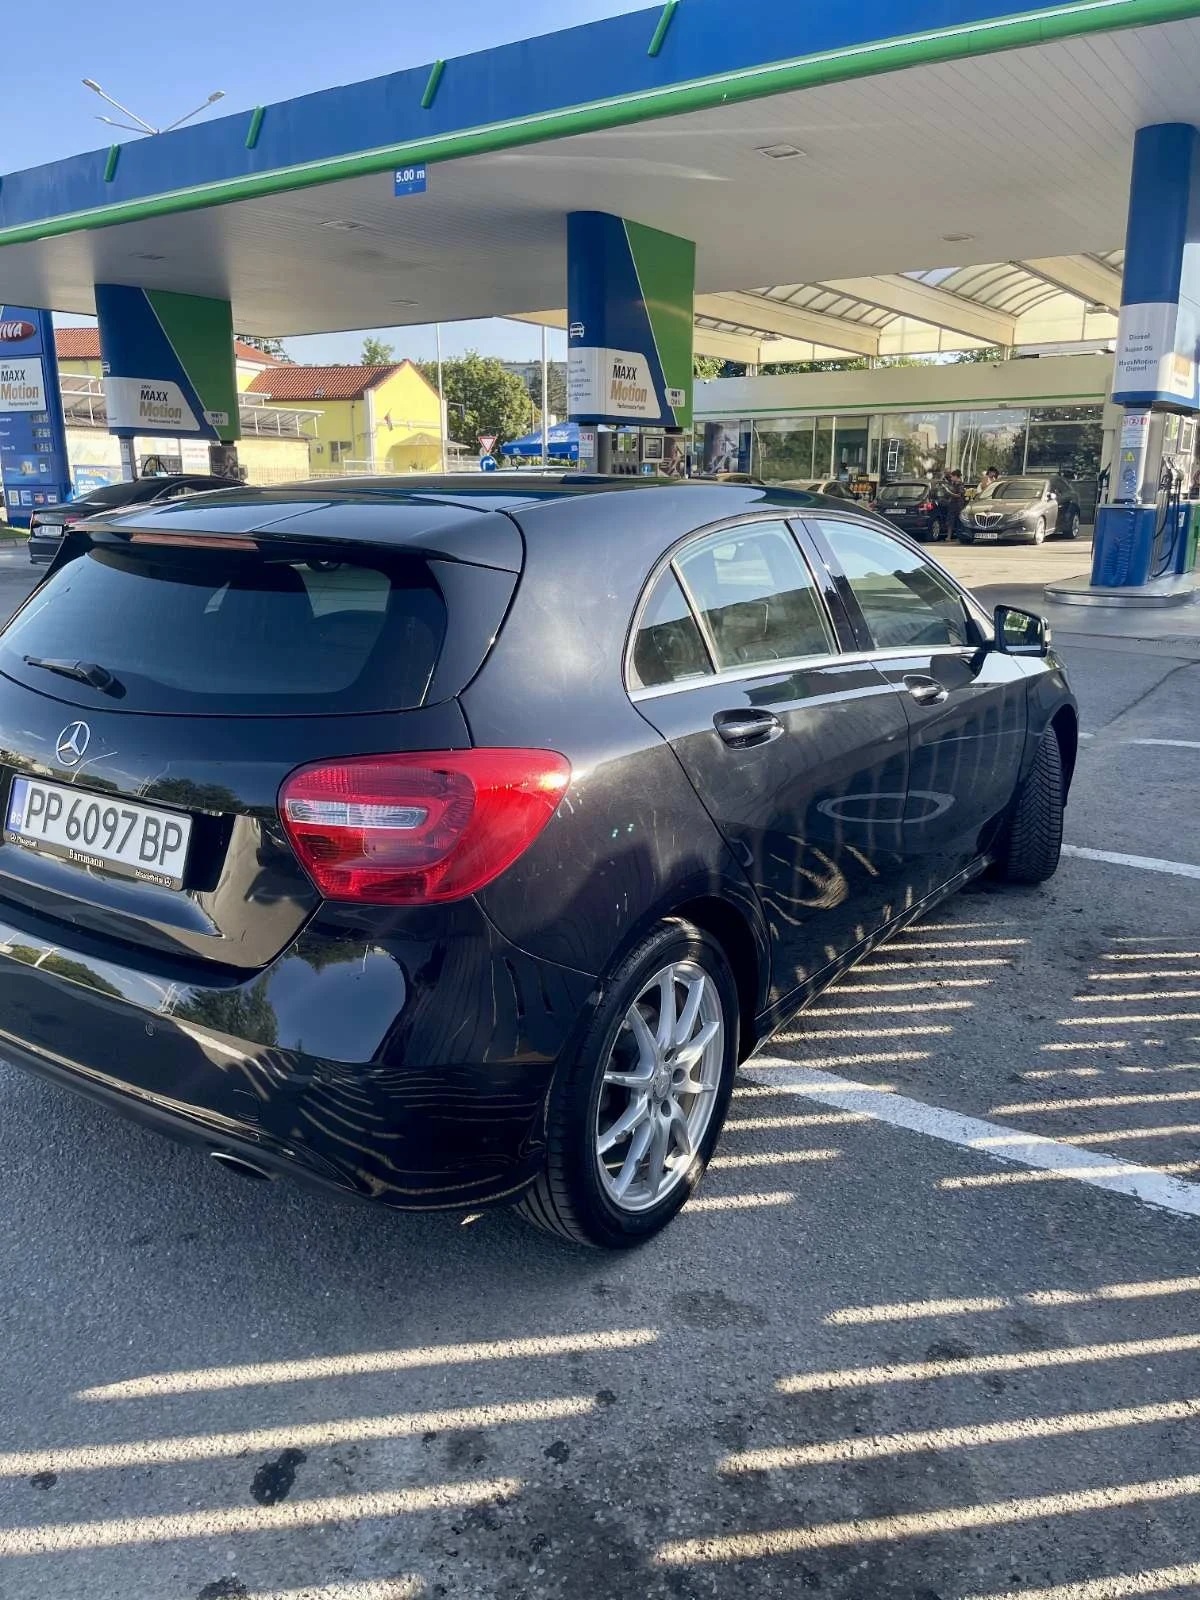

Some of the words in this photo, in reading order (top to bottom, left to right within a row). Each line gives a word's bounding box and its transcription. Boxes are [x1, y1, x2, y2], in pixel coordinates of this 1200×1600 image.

[396, 169, 414, 183] 5.00
[416, 169, 425, 179] m
[1, 369, 26, 381] MAXX
[613, 364, 637, 381] MAXX
[1, 383, 39, 400] Motion
[140, 389, 168, 401] MAXX
[610, 380, 648, 403] Motion
[139, 401, 182, 419] Motion
[25, 787, 63, 833] PP
[66, 797, 139, 854] 6097
[139, 815, 183, 866] BP
